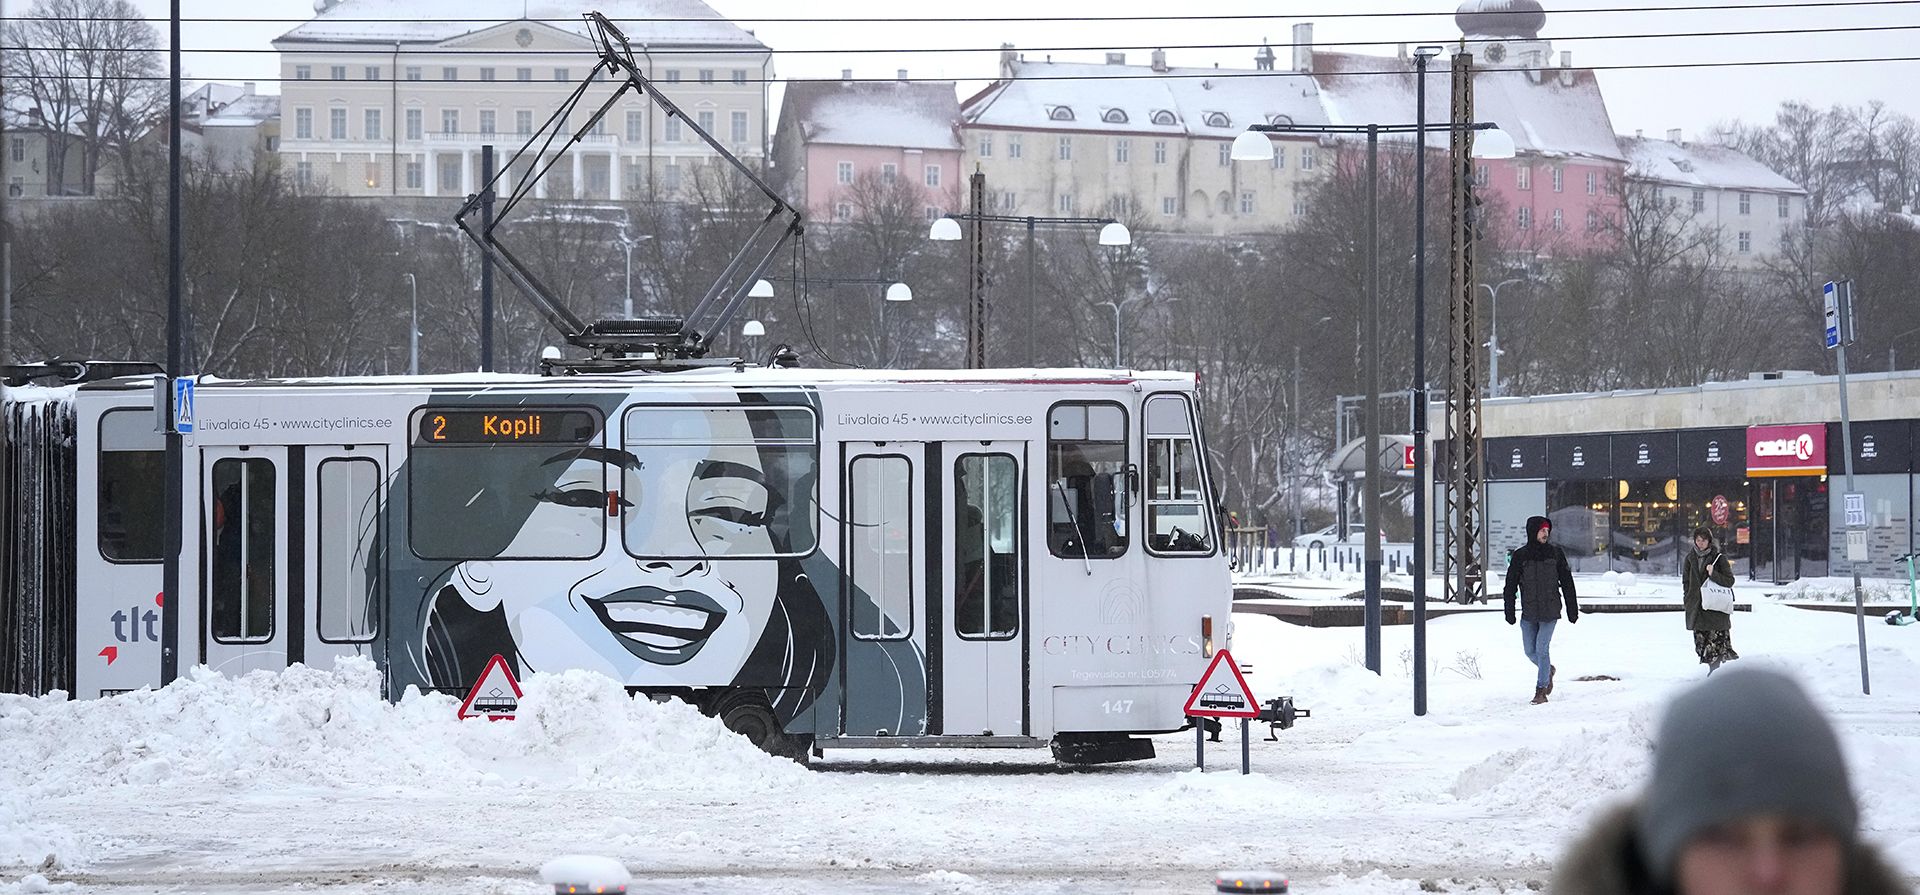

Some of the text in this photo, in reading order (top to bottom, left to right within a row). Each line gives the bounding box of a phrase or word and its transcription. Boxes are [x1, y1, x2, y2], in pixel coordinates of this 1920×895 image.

[199, 417, 393, 433] Liivalaia 45 www.cityclinics.ee
[433, 415, 542, 440] 2 Kopli
[837, 412, 1033, 427] Liivalaia 45 www.cityclinics.ee
[111, 606, 158, 642] tlt
[1043, 635, 1101, 655] CITY
[1071, 669, 1126, 680] Tegevusloa
[1102, 700, 1134, 714] 147
